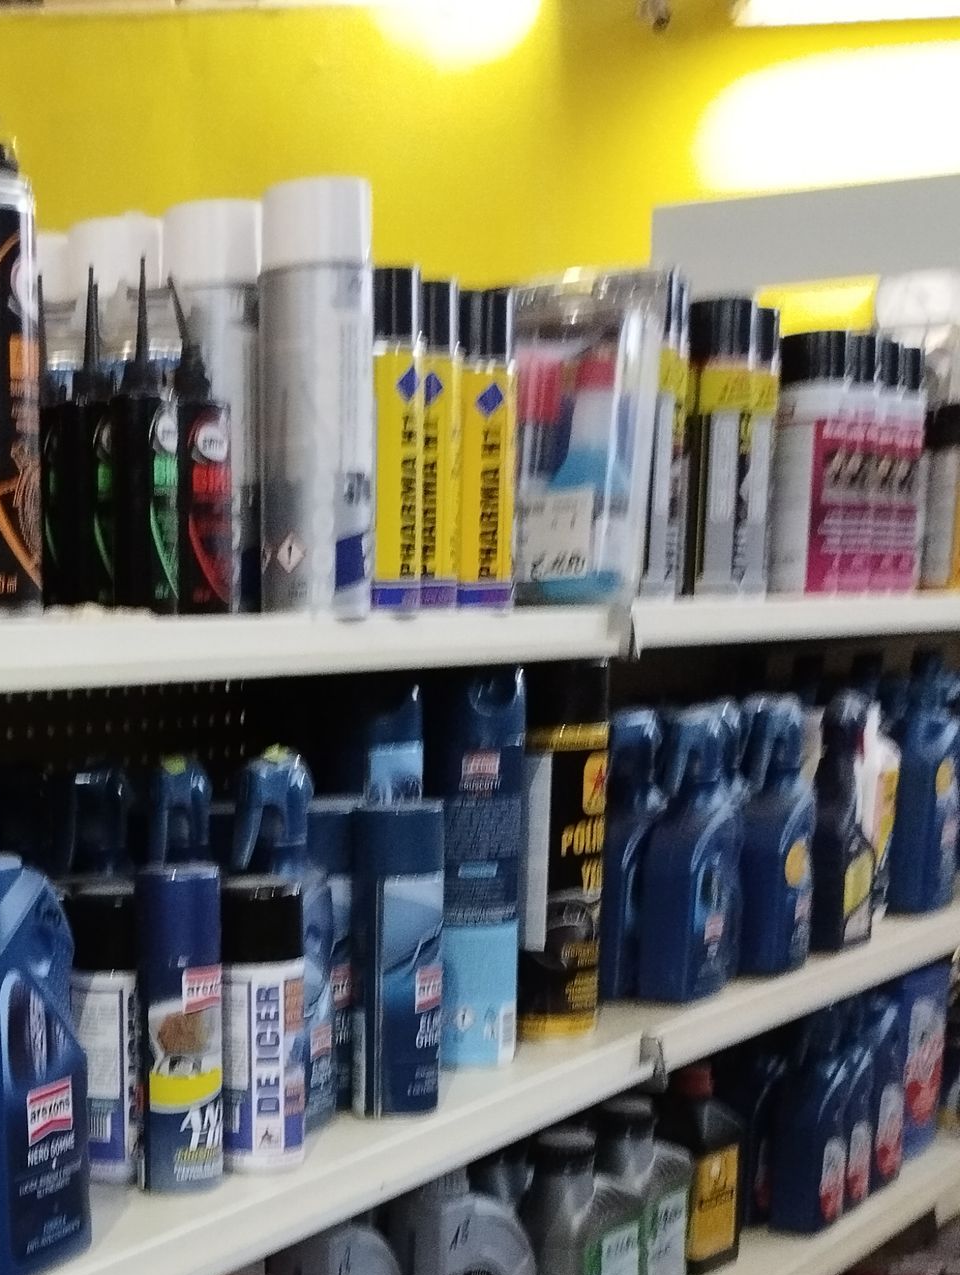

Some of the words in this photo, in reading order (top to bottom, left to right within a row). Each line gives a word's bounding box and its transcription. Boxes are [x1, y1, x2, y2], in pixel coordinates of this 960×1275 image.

[400, 458, 417, 579] PHARMA
[478, 468, 500, 579] PHARMA
[29, 1099, 70, 1126] arexons
